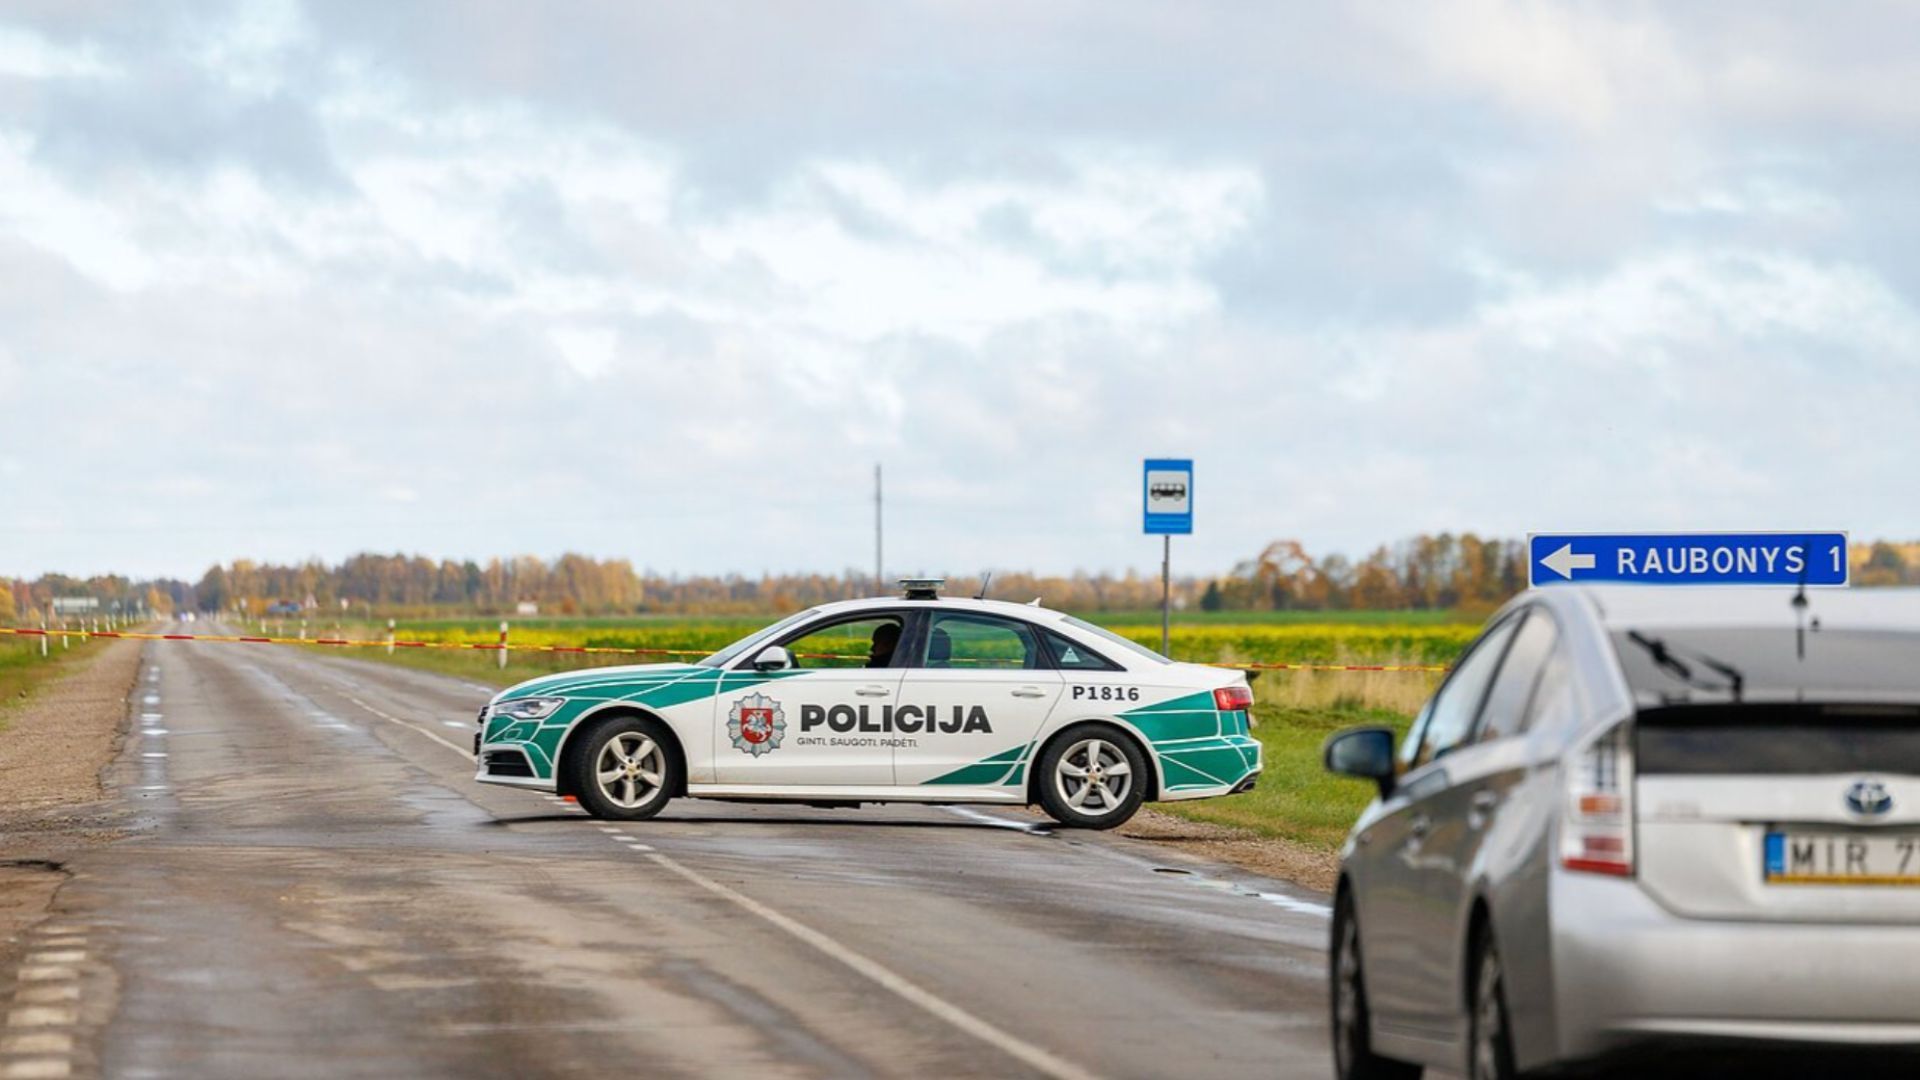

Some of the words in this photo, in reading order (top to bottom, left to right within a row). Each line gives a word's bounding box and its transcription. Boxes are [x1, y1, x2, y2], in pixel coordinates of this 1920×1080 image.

[1617, 546, 1805, 574] RAUBONYS
[1829, 546, 1840, 572] 1
[1072, 686, 1140, 701] P1816
[800, 703, 993, 734] POLICIJA
[1792, 841, 1869, 874] MIR
